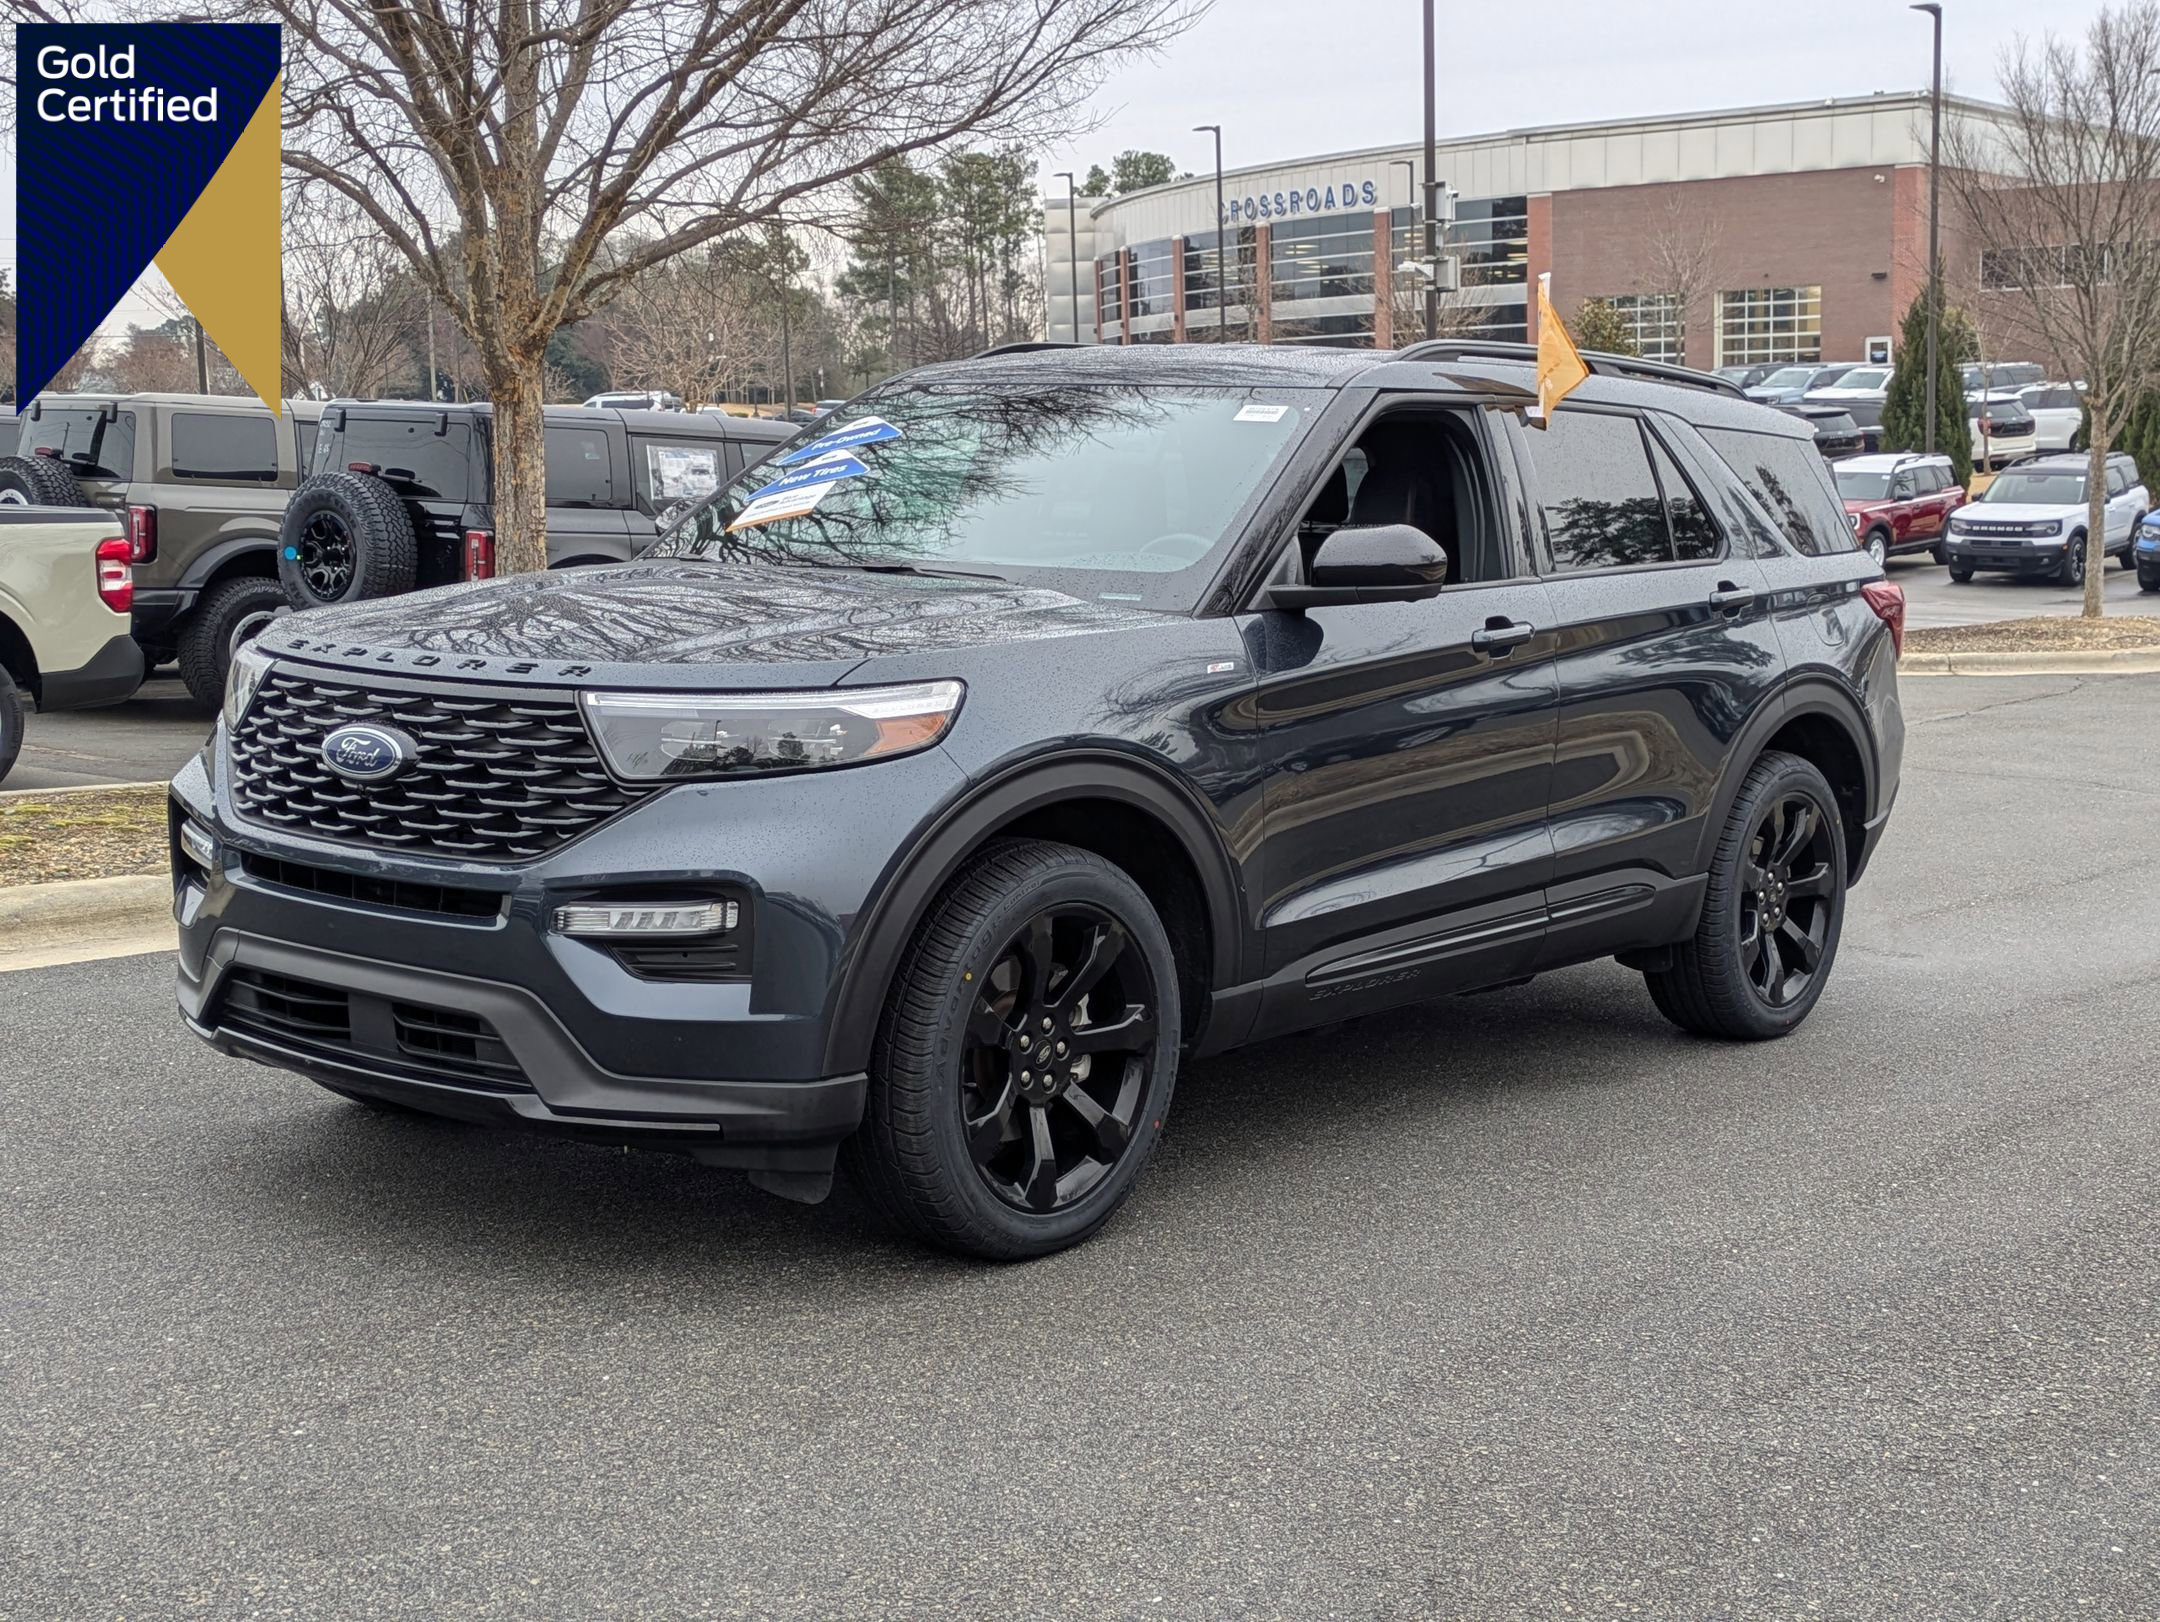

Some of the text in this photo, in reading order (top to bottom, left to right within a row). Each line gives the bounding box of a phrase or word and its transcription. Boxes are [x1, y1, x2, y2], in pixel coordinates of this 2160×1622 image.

[811, 427, 882, 451] Pre-Owned
[778, 464, 849, 487] New Tires
[287, 638, 593, 678] EXPLORER
[336, 736, 380, 767] Ford
[1308, 968, 1423, 1001] EXPLORER
